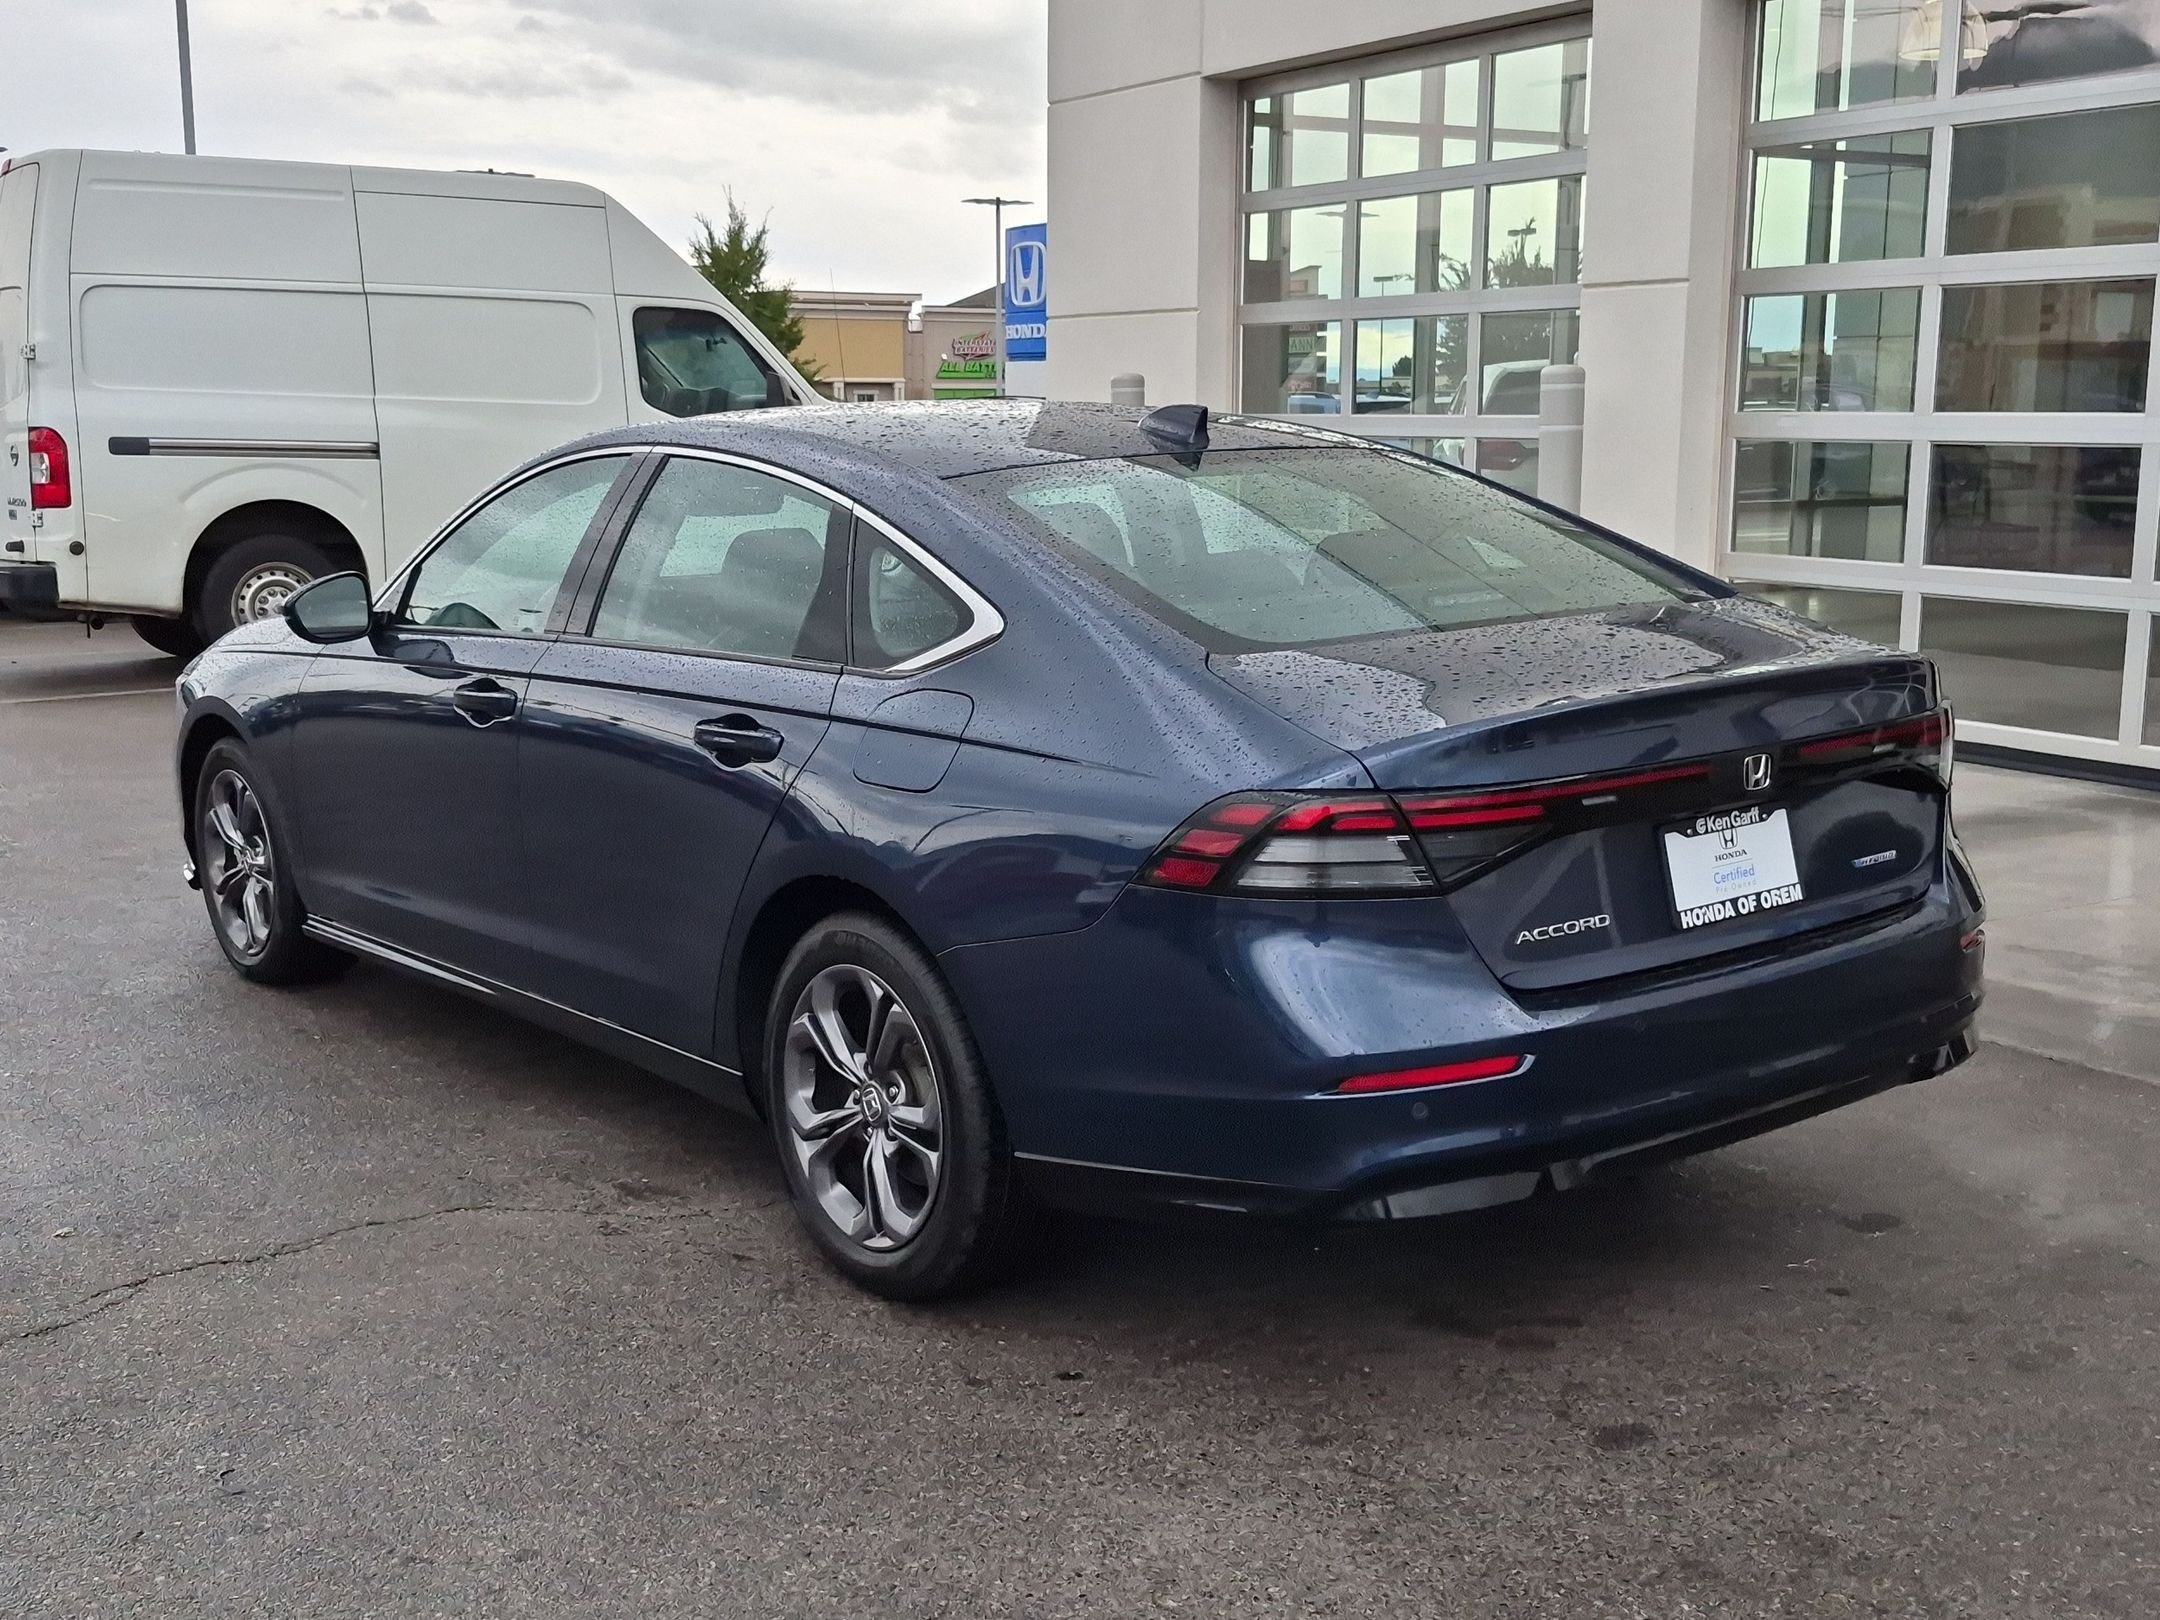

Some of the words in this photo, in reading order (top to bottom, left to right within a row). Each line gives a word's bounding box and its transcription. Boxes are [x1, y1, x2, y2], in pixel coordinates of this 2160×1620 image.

[1006, 323, 1046, 339] HOND
[965, 361, 997, 373] BATT
[1714, 849, 1748, 862] HONDA
[1713, 864, 1755, 884] Certified
[1680, 901, 1736, 929] HONDA
[1737, 895, 1757, 915] OF
[1760, 883, 1803, 909] OREM
[1516, 914, 1610, 945] ACCORD
